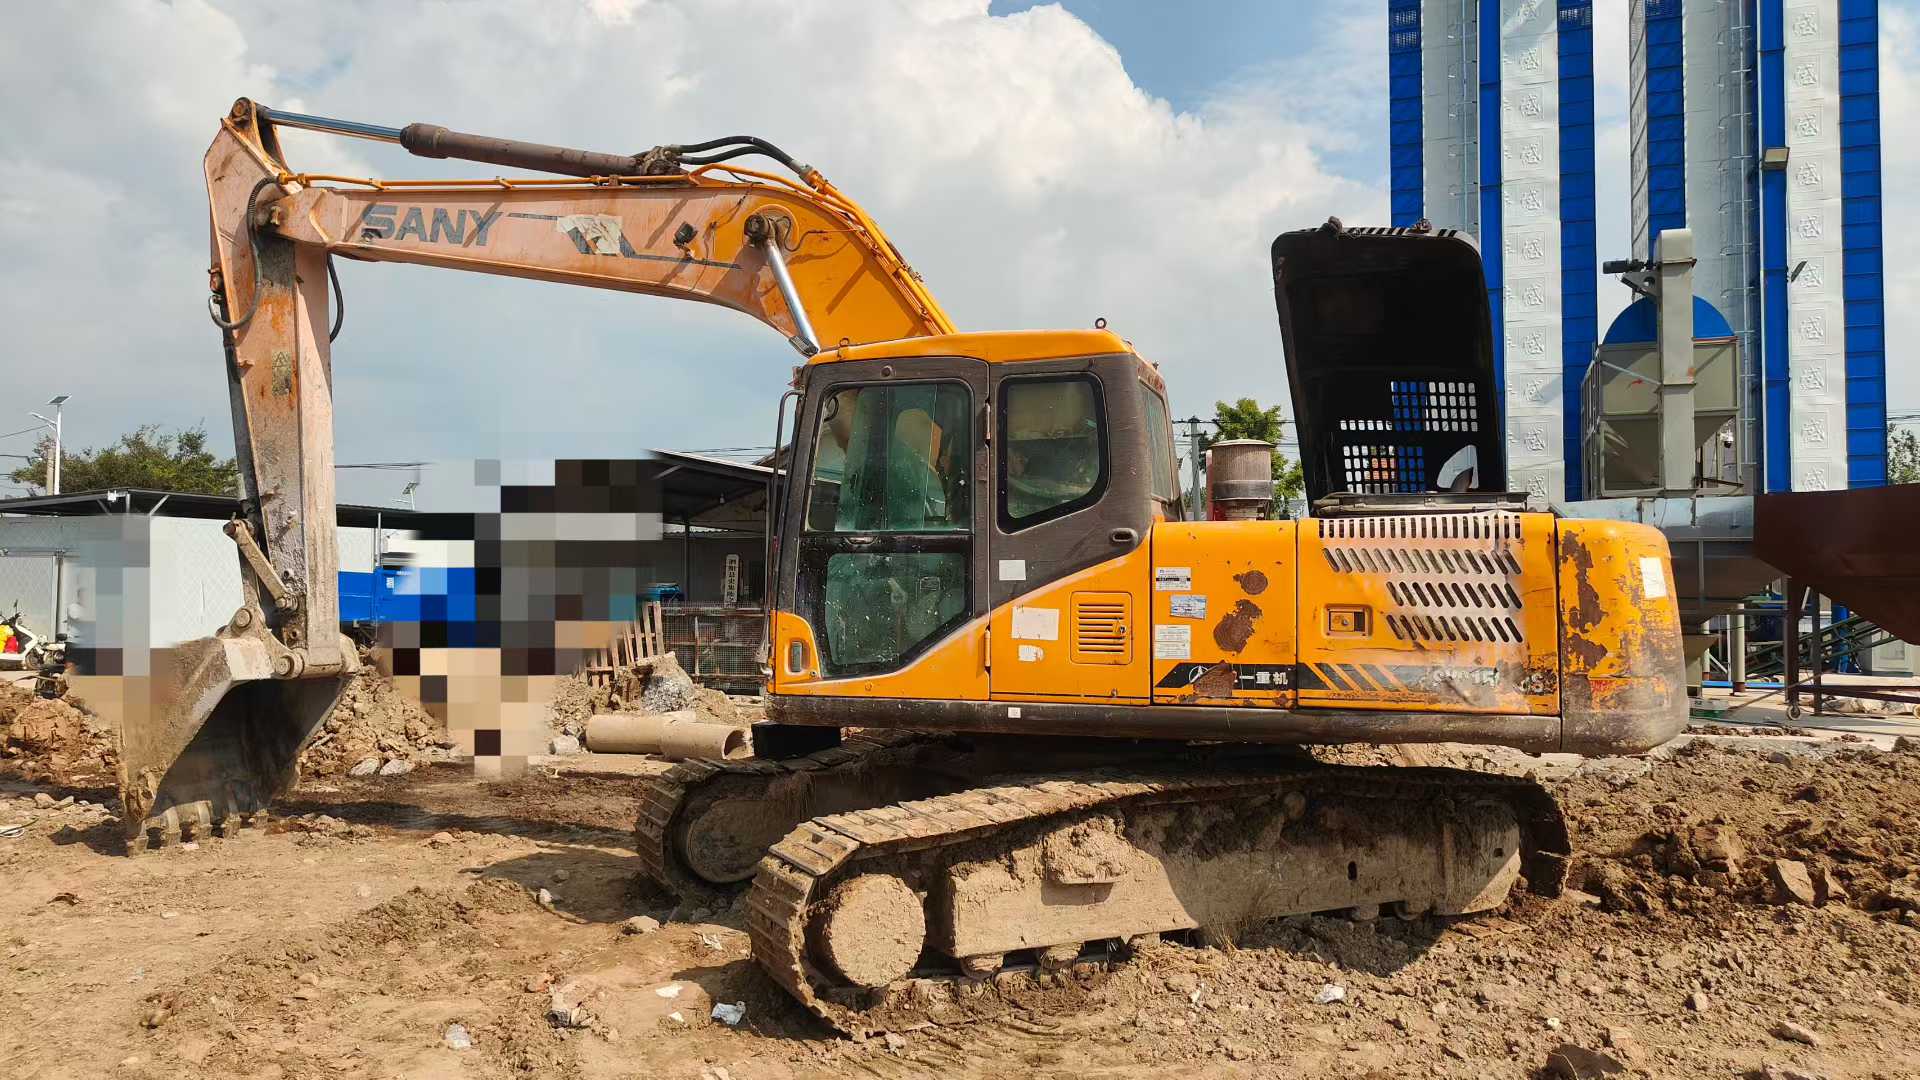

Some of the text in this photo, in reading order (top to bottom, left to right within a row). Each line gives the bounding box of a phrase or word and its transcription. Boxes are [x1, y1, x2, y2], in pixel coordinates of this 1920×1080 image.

[362, 205, 504, 246] SANY
[1233, 670, 1289, 685] 一重机
